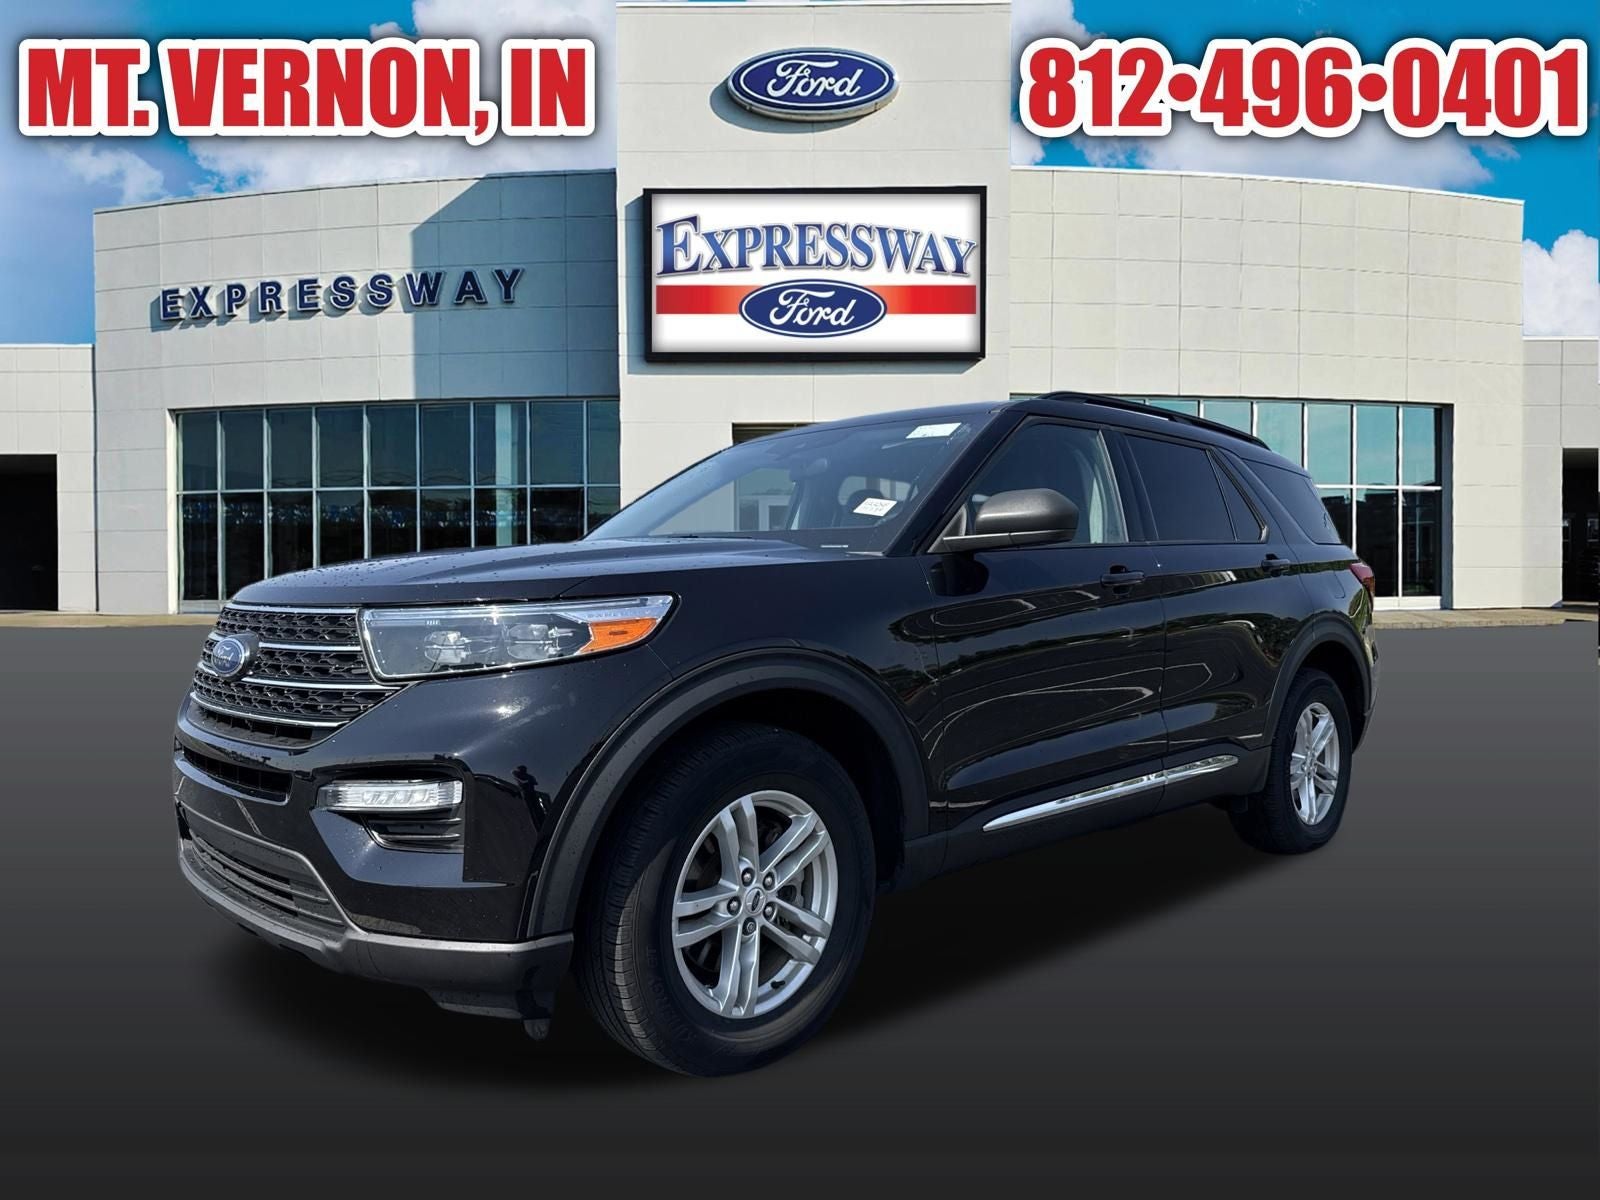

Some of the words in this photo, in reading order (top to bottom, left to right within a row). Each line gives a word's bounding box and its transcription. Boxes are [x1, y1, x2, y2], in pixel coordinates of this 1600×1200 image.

[766, 59, 864, 98] Ford
[159, 267, 525, 322] EXPRESSWAY
[769, 288, 856, 327] Ford
